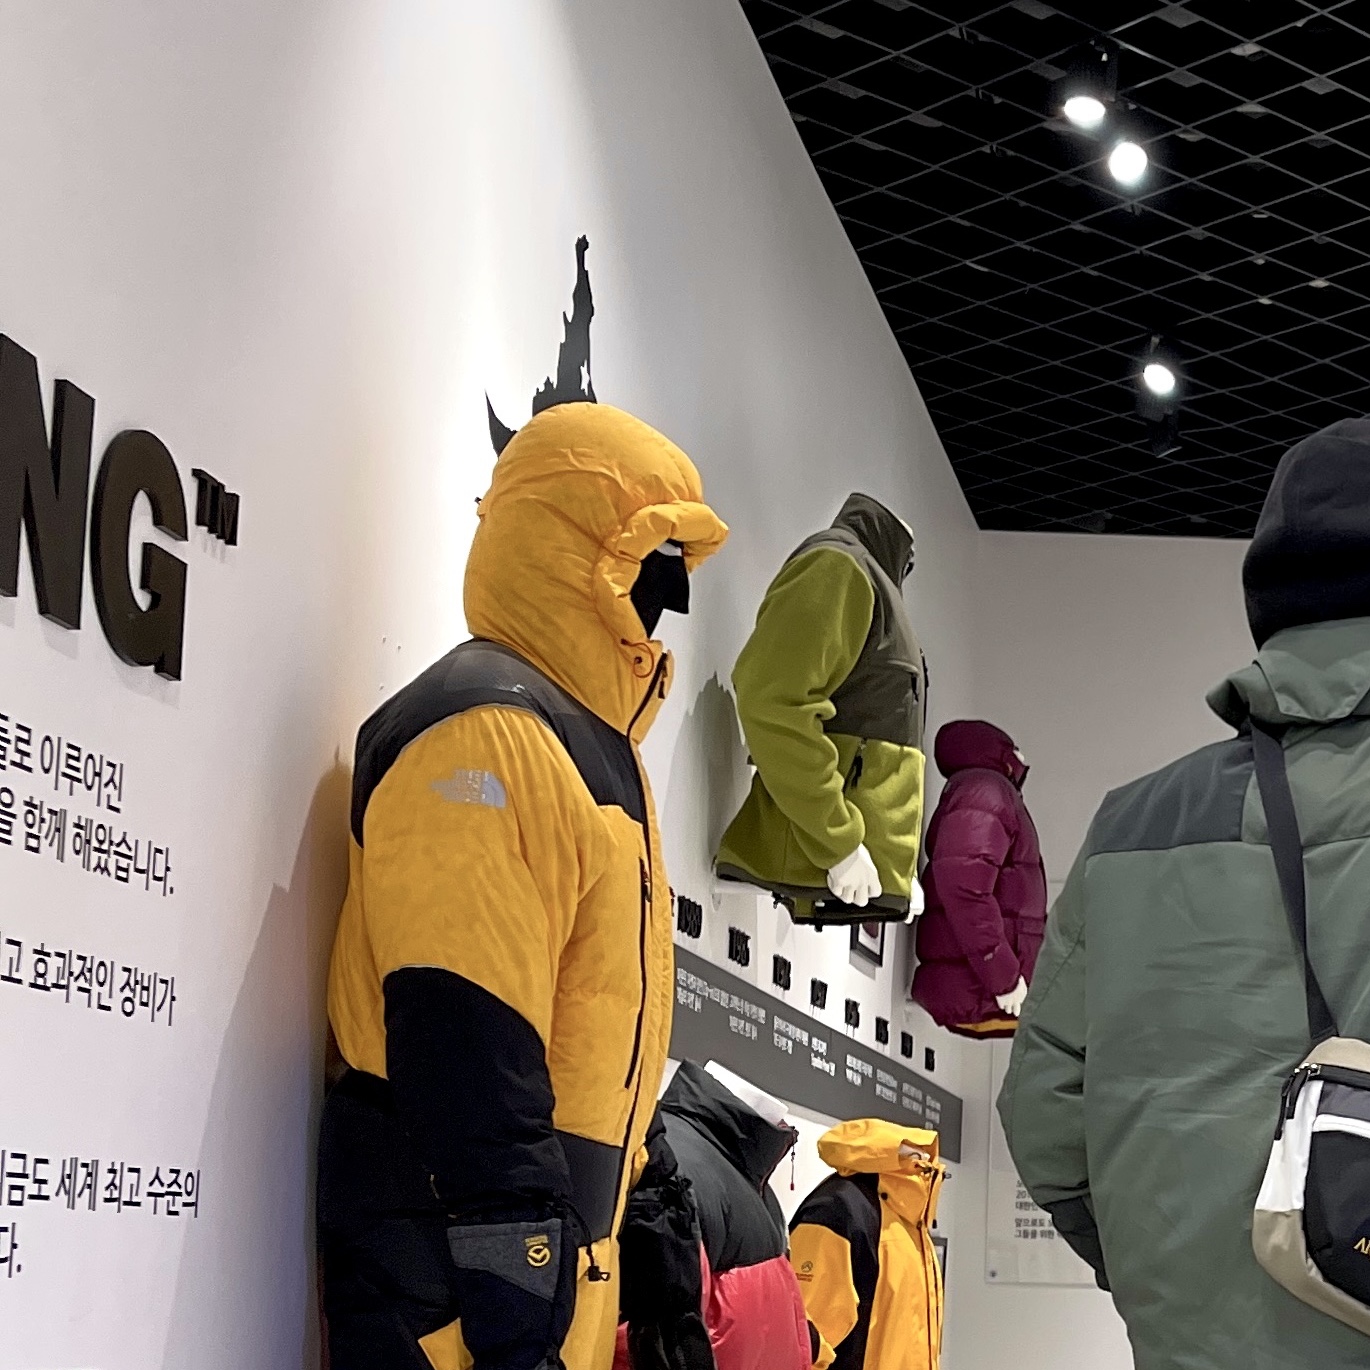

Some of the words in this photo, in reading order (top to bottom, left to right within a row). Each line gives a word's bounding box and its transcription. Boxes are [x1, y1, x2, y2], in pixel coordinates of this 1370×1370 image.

[40, 735, 124, 814] 이루어진
[23, 796, 67, 863] 함께
[72, 815, 174, 897] 해왔습니다.
[29, 943, 115, 1012] 효과적인
[120, 964, 176, 1027] 장비가
[0, 1150, 50, 1207] 금도
[55, 1157, 99, 1212] 세계
[103, 1161, 142, 1213] 최고
[147, 1166, 200, 1218] 수준의
